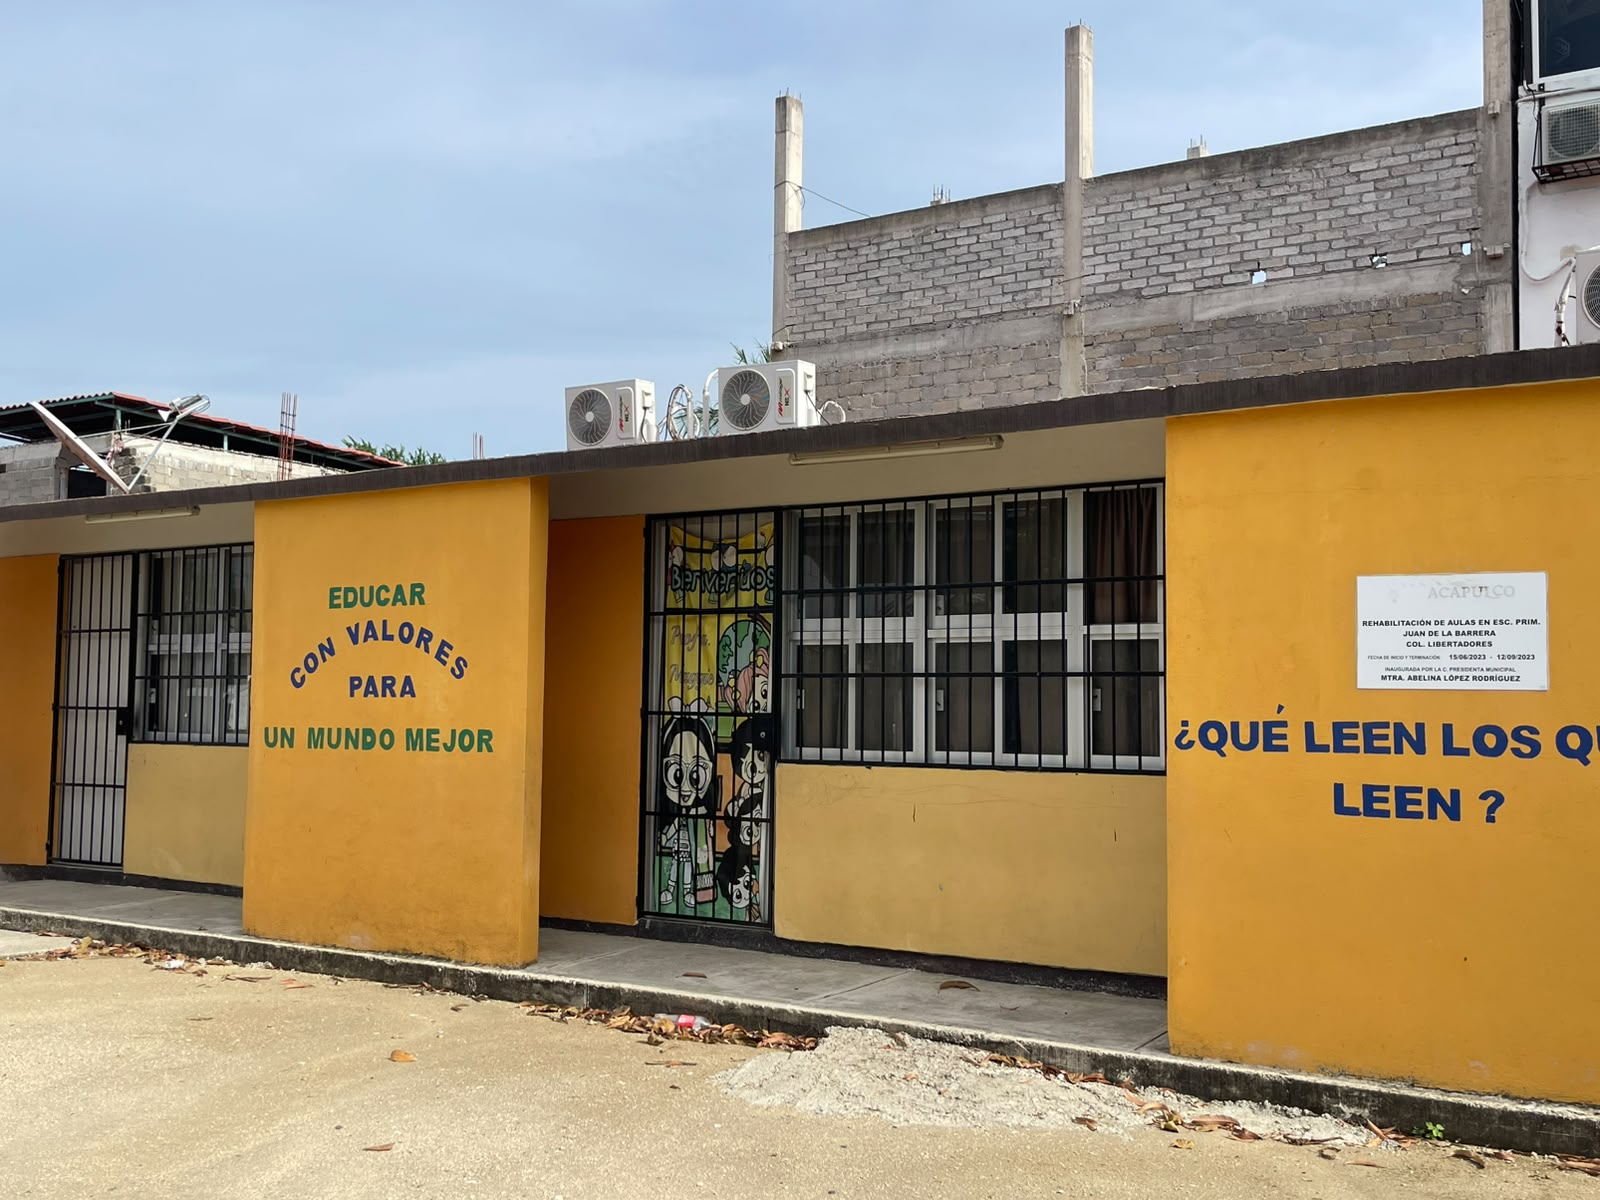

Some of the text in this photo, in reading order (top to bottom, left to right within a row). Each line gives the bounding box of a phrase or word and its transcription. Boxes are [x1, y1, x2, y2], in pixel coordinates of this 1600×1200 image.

[329, 583, 425, 609] EDUCAR
[1428, 585, 1516, 600] ACAPULCO
[1362, 619, 1431, 627] REHABILITACIÓN
[290, 620, 467, 689] CON VALORES
[350, 676, 416, 697] PARA
[1444, 674, 1470, 682] LÓPEZ
[1472, 674, 1521, 682] RODRÍGUEZ
[264, 727, 493, 752] UN MUNDO MEJOR
[1175, 704, 1600, 767] ¿QUÉ LEEN LOS Q
[1333, 783, 1505, 824] LEEN ?
